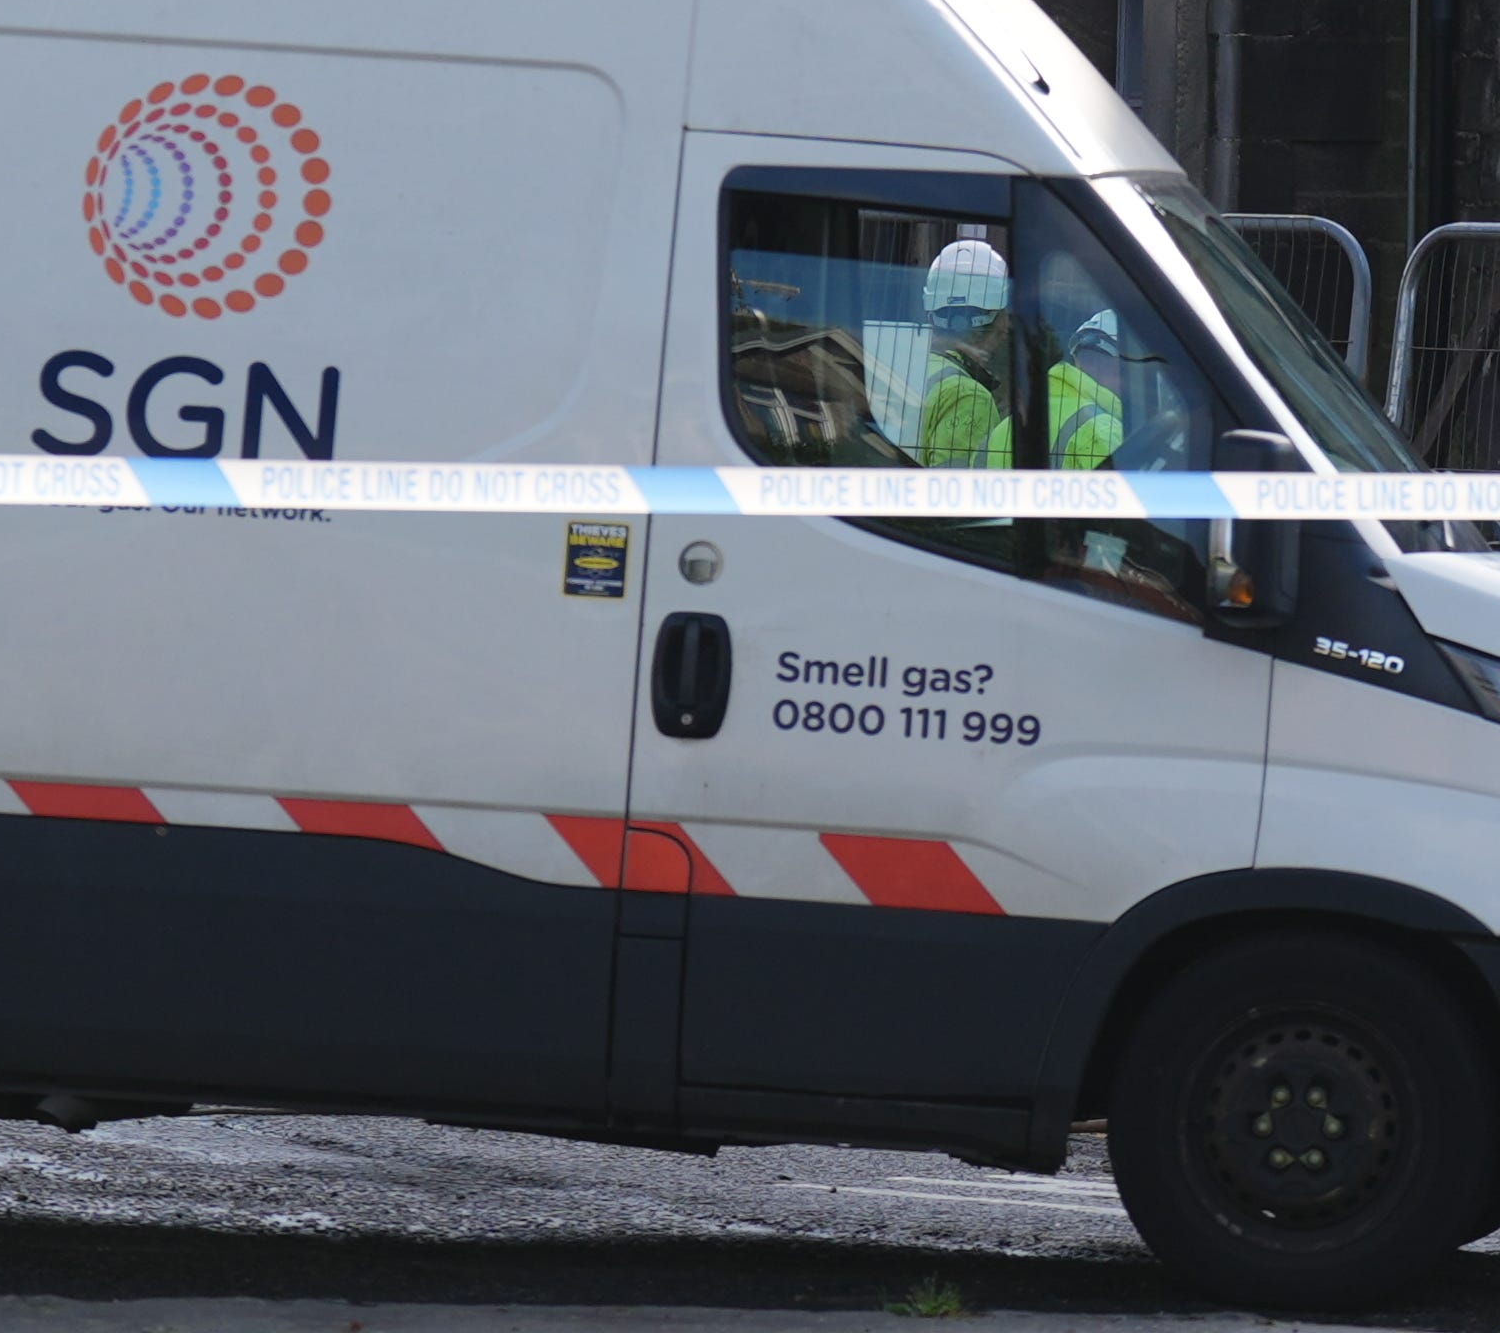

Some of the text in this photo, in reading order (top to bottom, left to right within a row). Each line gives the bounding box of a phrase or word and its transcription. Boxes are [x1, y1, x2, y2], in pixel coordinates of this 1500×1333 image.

[30, 349, 340, 460] SGN
[30, 463, 119, 497] CROSS
[261, 467, 620, 505] POLICE LINE DO NOT CROSS
[760, 474, 1117, 510] POLICE LINE DO NOT CROSS
[1257, 477, 1344, 511] POLICE
[1355, 477, 1412, 511] LINE
[1423, 477, 1456, 511] DO
[569, 534, 625, 548] BEWARE
[571, 523, 627, 538] THIEVES
[1313, 636, 1405, 674] 35-120
[776, 651, 994, 697] Smell gas?
[772, 699, 1041, 746] 0800 111 999
